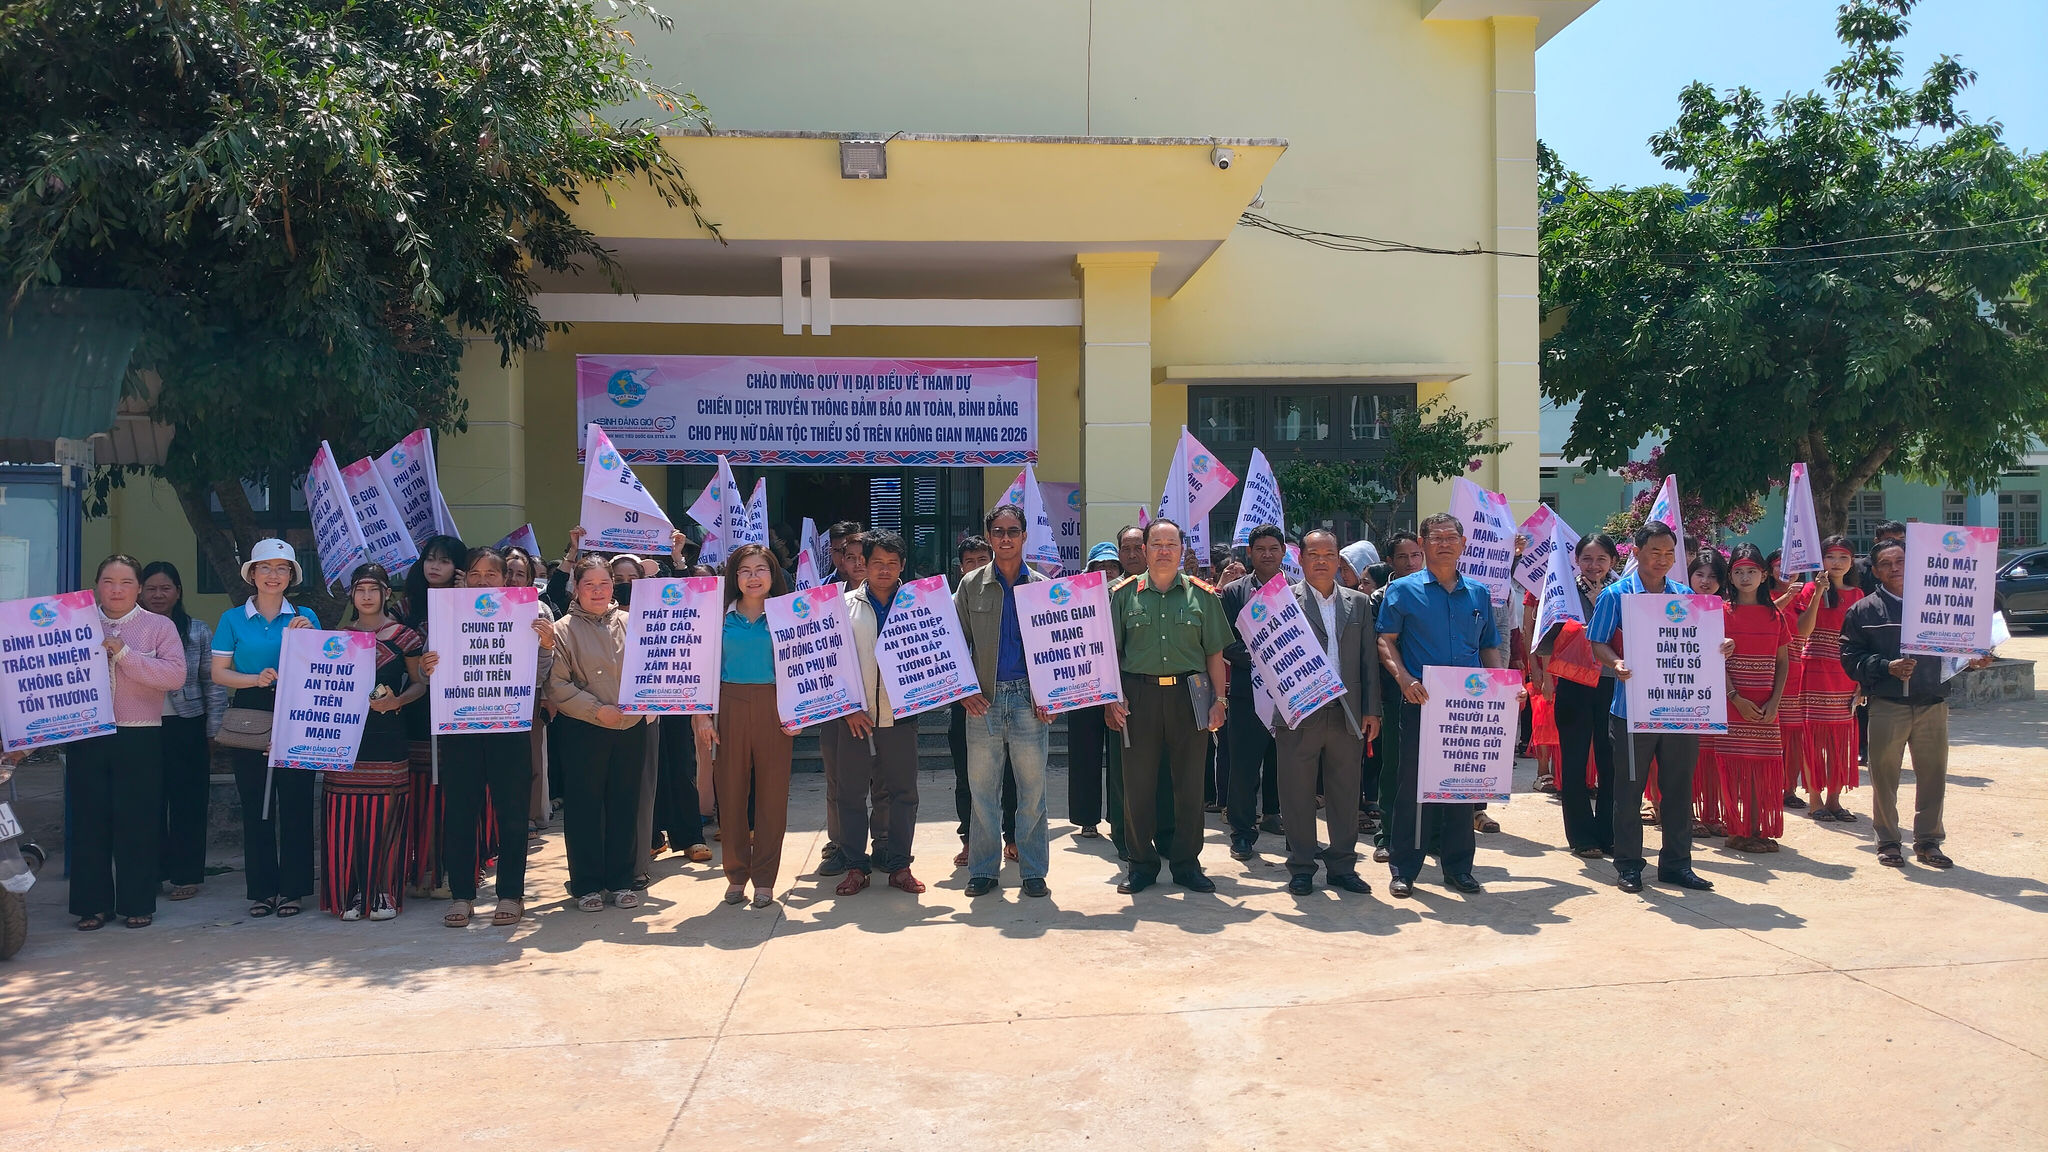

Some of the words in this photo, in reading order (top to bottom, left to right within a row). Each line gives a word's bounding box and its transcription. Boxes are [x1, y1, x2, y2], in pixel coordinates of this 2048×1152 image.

[746, 373, 778, 389] CHÀO
[780, 372, 814, 390] MỪNG
[818, 372, 839, 391] QUÝ
[842, 375, 853, 393] VỊ
[856, 375, 874, 393] ĐẠI
[878, 369, 902, 390] BIỂU
[906, 370, 919, 390] VỀ
[922, 375, 953, 390] THAM
[956, 375, 972, 393] DỰ
[697, 396, 732, 414] CHIẾN
[735, 400, 762, 417] DỊCH
[765, 396, 808, 415] TRUYỀN
[811, 398, 848, 416] THÔNG
[851, 397, 876, 416] ĐẢM
[880, 397, 901, 416] BẢO
[904, 401, 920, 416] AN
[923, 398, 956, 418] TOÀN,
[958, 399, 985, 416] BÌNH
[988, 394, 1018, 416] ĐẲNG
[688, 426, 711, 440] CHO
[714, 427, 738, 444] PHỤ
[741, 423, 757, 441] NỮ
[759, 424, 783, 441] DÂN
[786, 423, 807, 444] TỘC
[810, 421, 842, 441] THIỂU
[845, 422, 860, 442] SỐ
[863, 424, 891, 442] TRÊN
[894, 425, 932, 442] KHÔNG
[935, 427, 962, 442] GIAN
[964, 427, 998, 445] MẠNG
[1001, 427, 1027, 442] 2026
[1953, 557, 1978, 573] MẬT
[1924, 574, 1948, 588] HÔM
[1952, 576, 1977, 591] NAY,
[1925, 594, 1940, 606] AN
[1944, 594, 1973, 608] TOÀN
[642, 608, 669, 619] PHÁT
[672, 608, 700, 620] HIỆN,
[888, 612, 909, 624] LAN
[1031, 610, 1068, 627] KHÔNG
[1071, 605, 1096, 619] GIAN
[1953, 614, 1975, 626] MAI
[462, 622, 495, 633] CHUNG
[498, 622, 514, 632] TAY
[646, 622, 666, 632] BÁO
[670, 621, 694, 632] CÁO,
[882, 622, 917, 638] THÔNG
[920, 616, 943, 629] ĐIỆP
[2, 633, 35, 653] BÌNH
[38, 628, 72, 647] LUẬN
[76, 624, 93, 640] CÓ
[884, 640, 899, 651] AN
[901, 634, 930, 646] TOÀN
[932, 624, 950, 638] SỐ,
[1051, 626, 1084, 644] MẠNG
[1659, 628, 1678, 640] PHỤ
[470, 636, 489, 649] XÓA
[492, 635, 505, 649] BỎ
[1657, 641, 1677, 653] DÂN
[1680, 642, 1700, 655] TỘC
[648, 648, 676, 658] HÀNH
[680, 649, 690, 657] VI
[896, 648, 920, 660] VUN
[1034, 648, 1071, 665] KHÔNG
[1073, 642, 1086, 658] KỲ
[1089, 641, 1104, 656] THỊ
[2, 655, 45, 674] TRÁCH
[48, 647, 91, 667] NHIỆM
[462, 655, 486, 668] ĐỊNH
[672, 662, 691, 672] HẠI
[896, 658, 932, 673] TƯƠNG
[934, 650, 951, 661] LAI
[1687, 655, 1701, 668] SỐ
[310, 663, 332, 676] PHỤ
[464, 669, 483, 682] GIỚI
[486, 669, 511, 681] TRÊN
[1053, 666, 1076, 680] PHỤ
[18, 674, 63, 692] KHÔNG
[67, 667, 91, 684] GÂY
[304, 679, 321, 690] AN
[325, 679, 354, 692] TOÀN
[635, 674, 662, 684] TRÊN
[666, 675, 700, 686] MẠNG
[898, 672, 925, 686] BÌNH
[1664, 672, 1676, 686] TỰ
[1678, 674, 1694, 684] TIN
[47, 688, 98, 709] THƯƠNG
[444, 686, 474, 698] KHÔNG
[477, 687, 500, 698] GIAN
[504, 686, 531, 700] MẠNG
[1667, 688, 1694, 701] NHẬP
[1698, 686, 1712, 700] SỐ
[314, 694, 342, 707] TRÊN
[1446, 698, 1484, 710] KHÔNG
[1488, 701, 1505, 710] TIN
[290, 709, 330, 722] KHÔNG
[334, 713, 360, 724] GIAN
[1487, 714, 1499, 724] LẠ
[305, 727, 341, 740] MẠNG
[1439, 724, 1468, 734] TRÊN
[1471, 726, 1506, 736] MẠNG,
[1442, 736, 1480, 747] KHÔNG
[1443, 749, 1479, 760] THÔNG
[1482, 751, 1499, 760] TIN
[1454, 762, 1486, 772] RIÊNG
